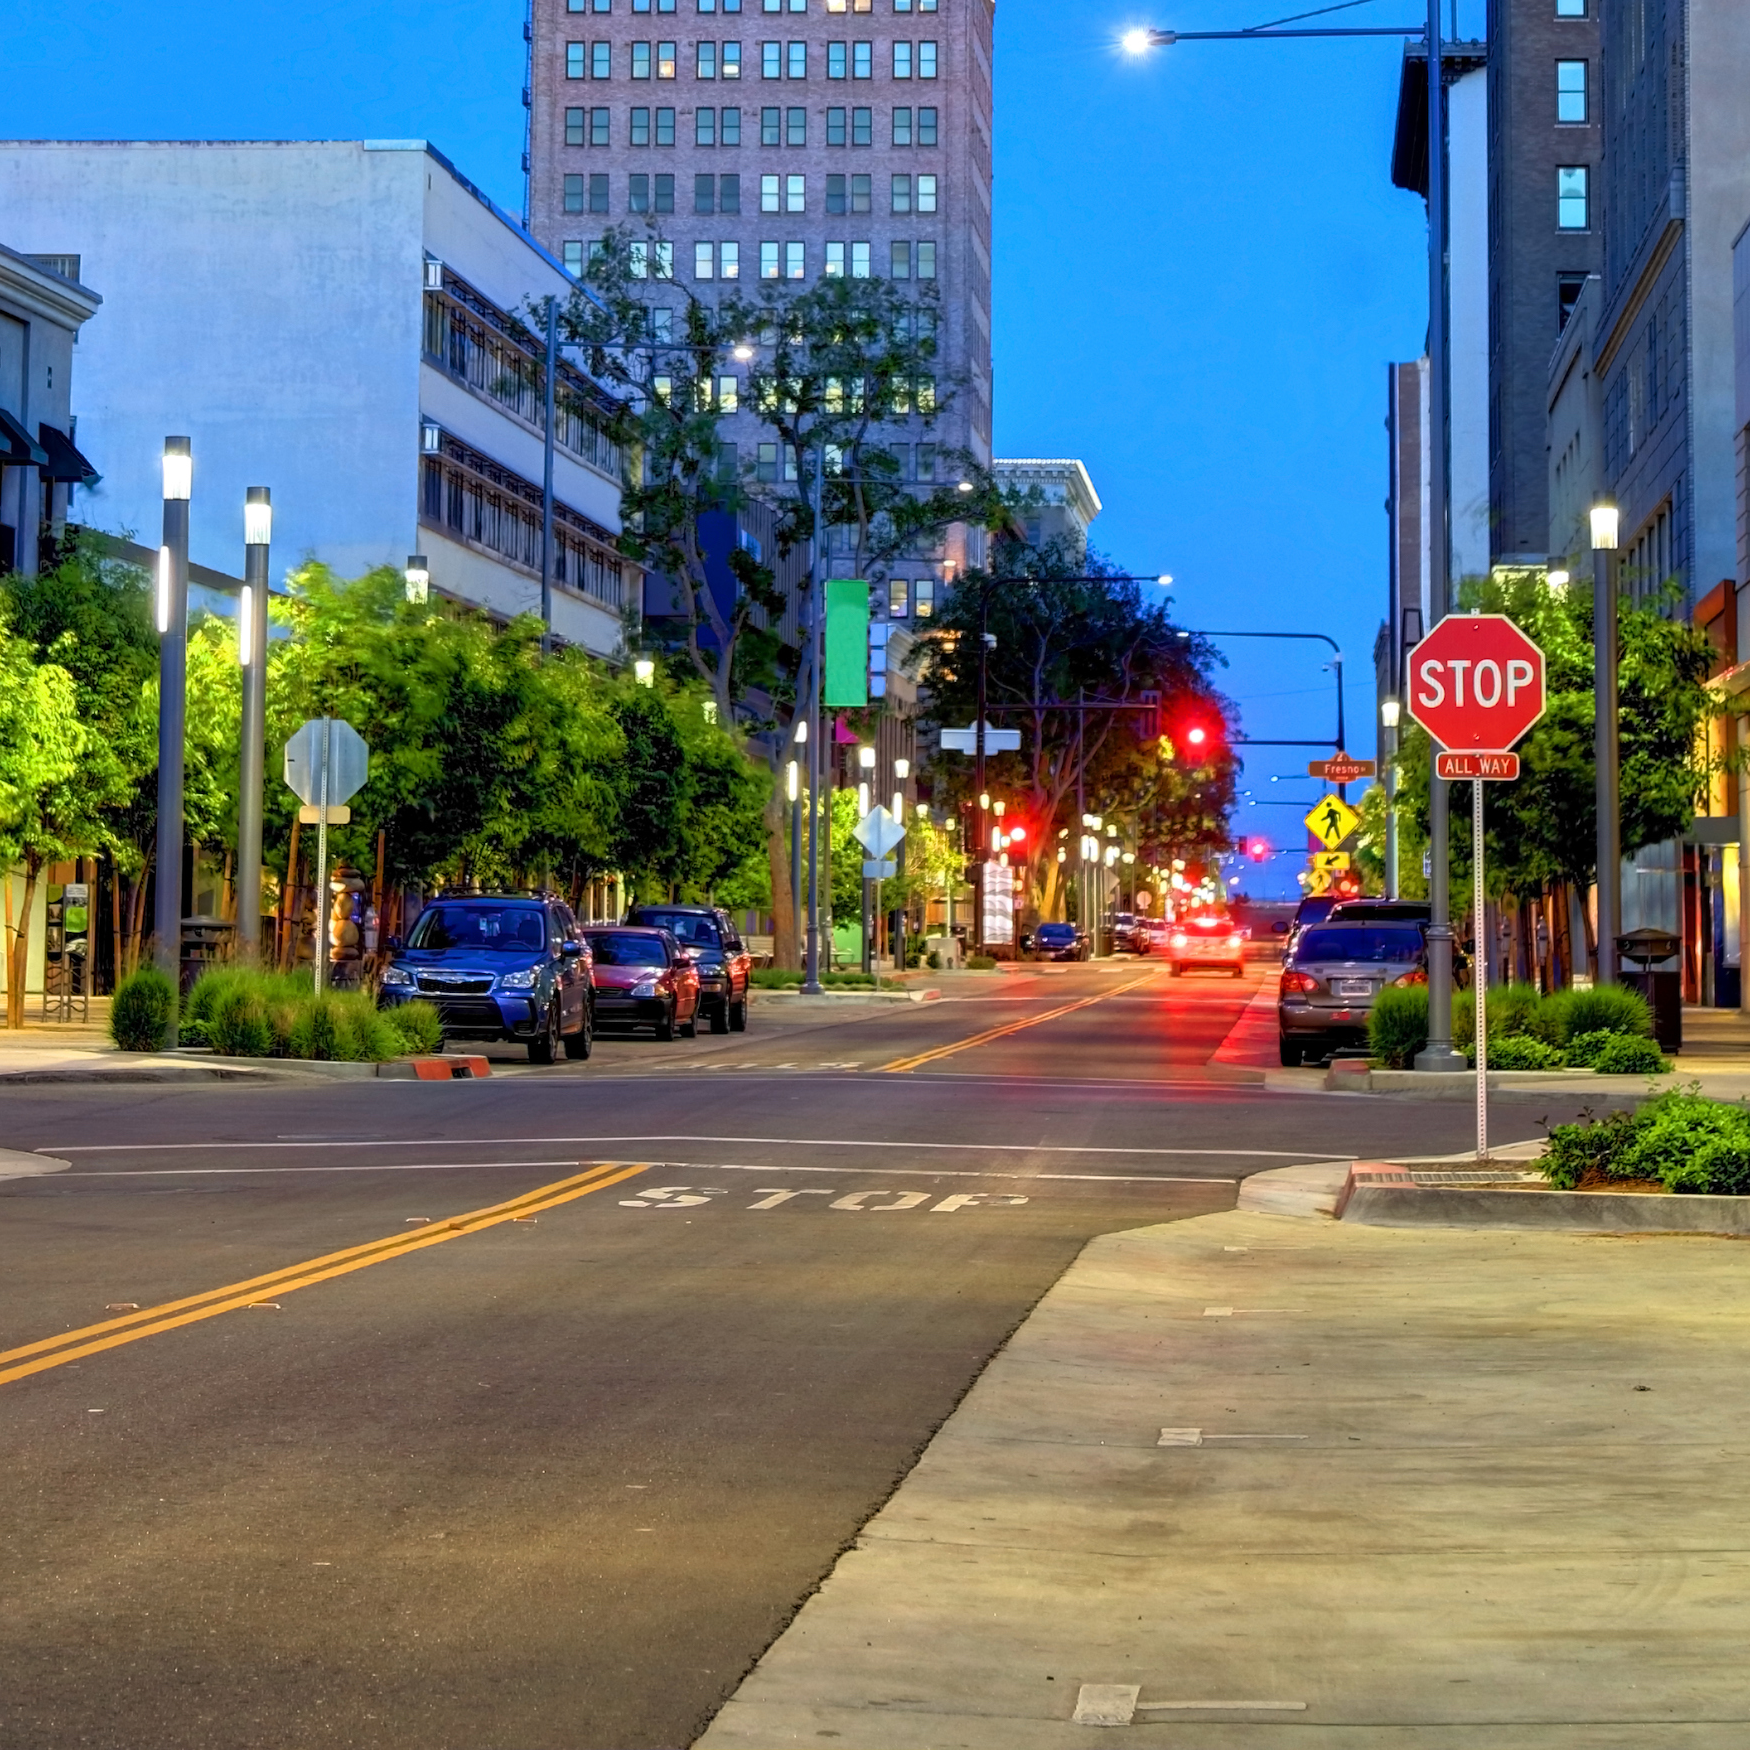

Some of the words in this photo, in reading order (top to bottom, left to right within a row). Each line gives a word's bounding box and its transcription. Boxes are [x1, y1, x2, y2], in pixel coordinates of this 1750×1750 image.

[1418, 659, 1534, 708] STOP
[1324, 764, 1360, 774] Fresno
[1444, 759, 1473, 775] ALL
[1479, 759, 1511, 775] WAY
[618, 1186, 1029, 1212] STOP
